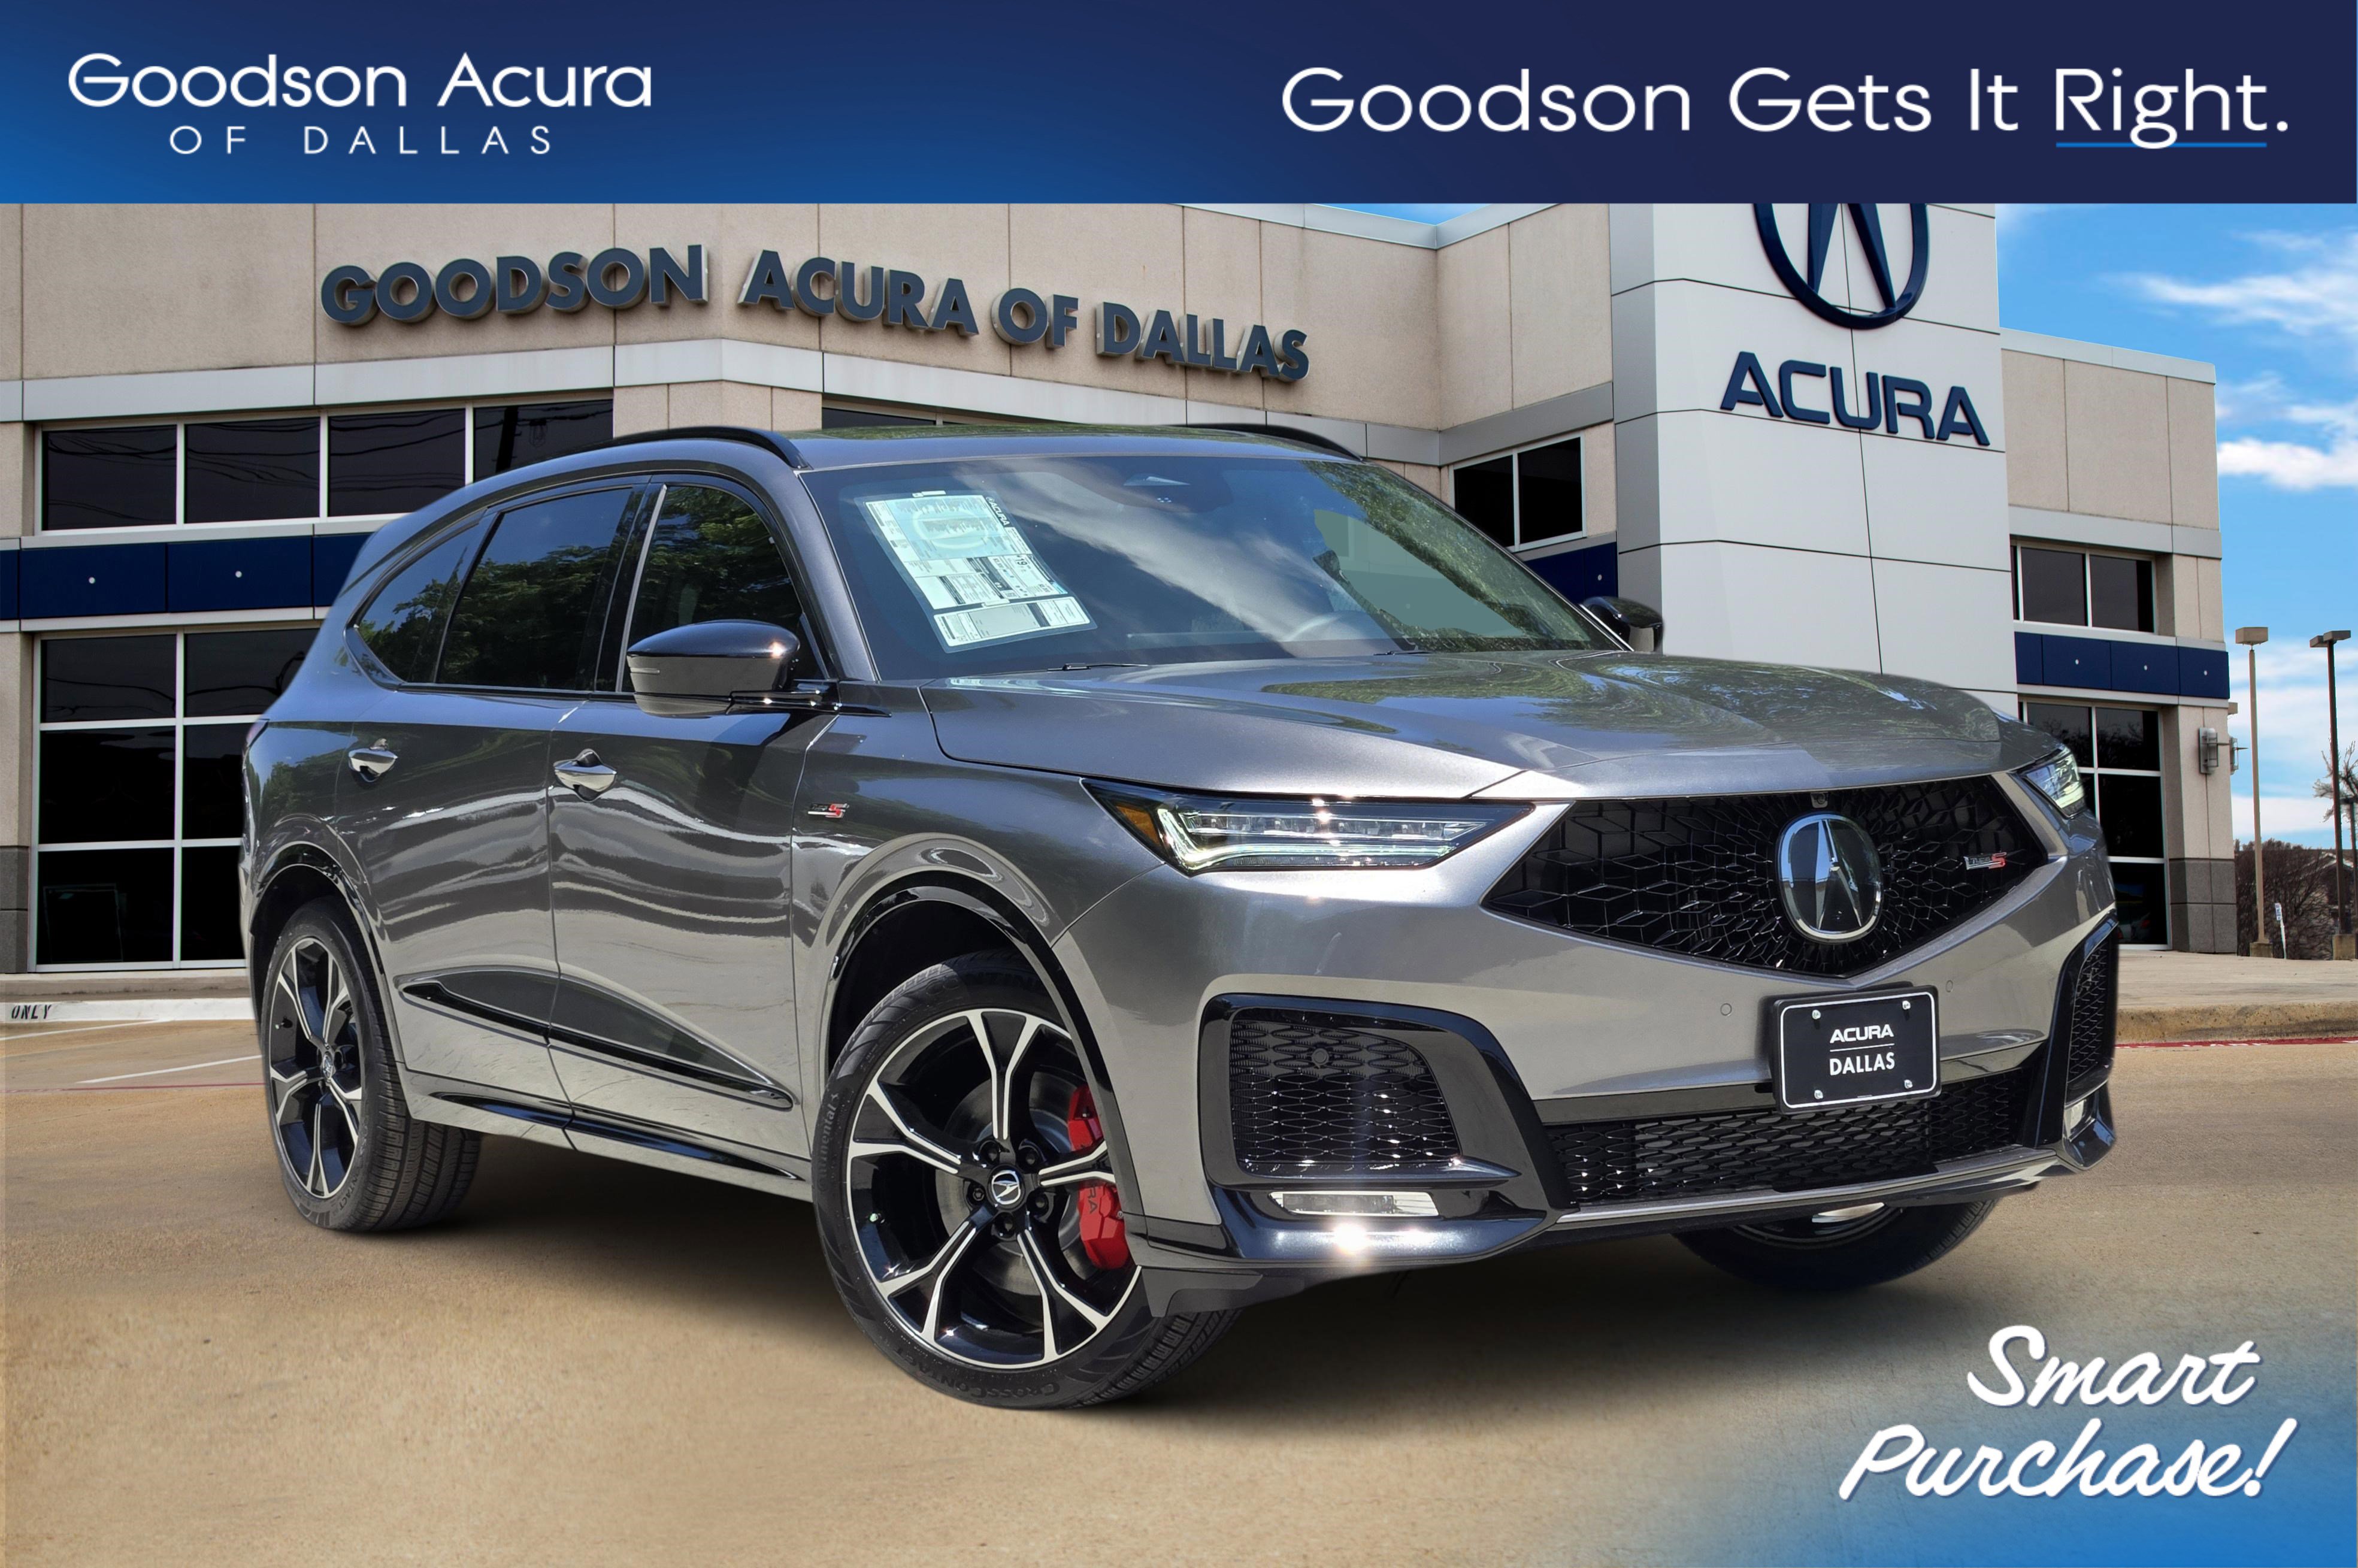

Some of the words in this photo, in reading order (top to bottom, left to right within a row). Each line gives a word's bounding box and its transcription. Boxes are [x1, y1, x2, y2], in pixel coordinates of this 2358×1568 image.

[320, 244, 709, 326] GOODSON
[737, 249, 979, 337] ACURA
[992, 287, 1079, 349] OF
[1096, 302, 1310, 382] DALLAS
[1720, 351, 1990, 446] ACURA
[989, 502, 1010, 526] ACURA
[11, 1004, 52, 1019] ONLY
[1829, 1024, 1894, 1044] ACURA
[1829, 1052, 1896, 1076] DALLAS
